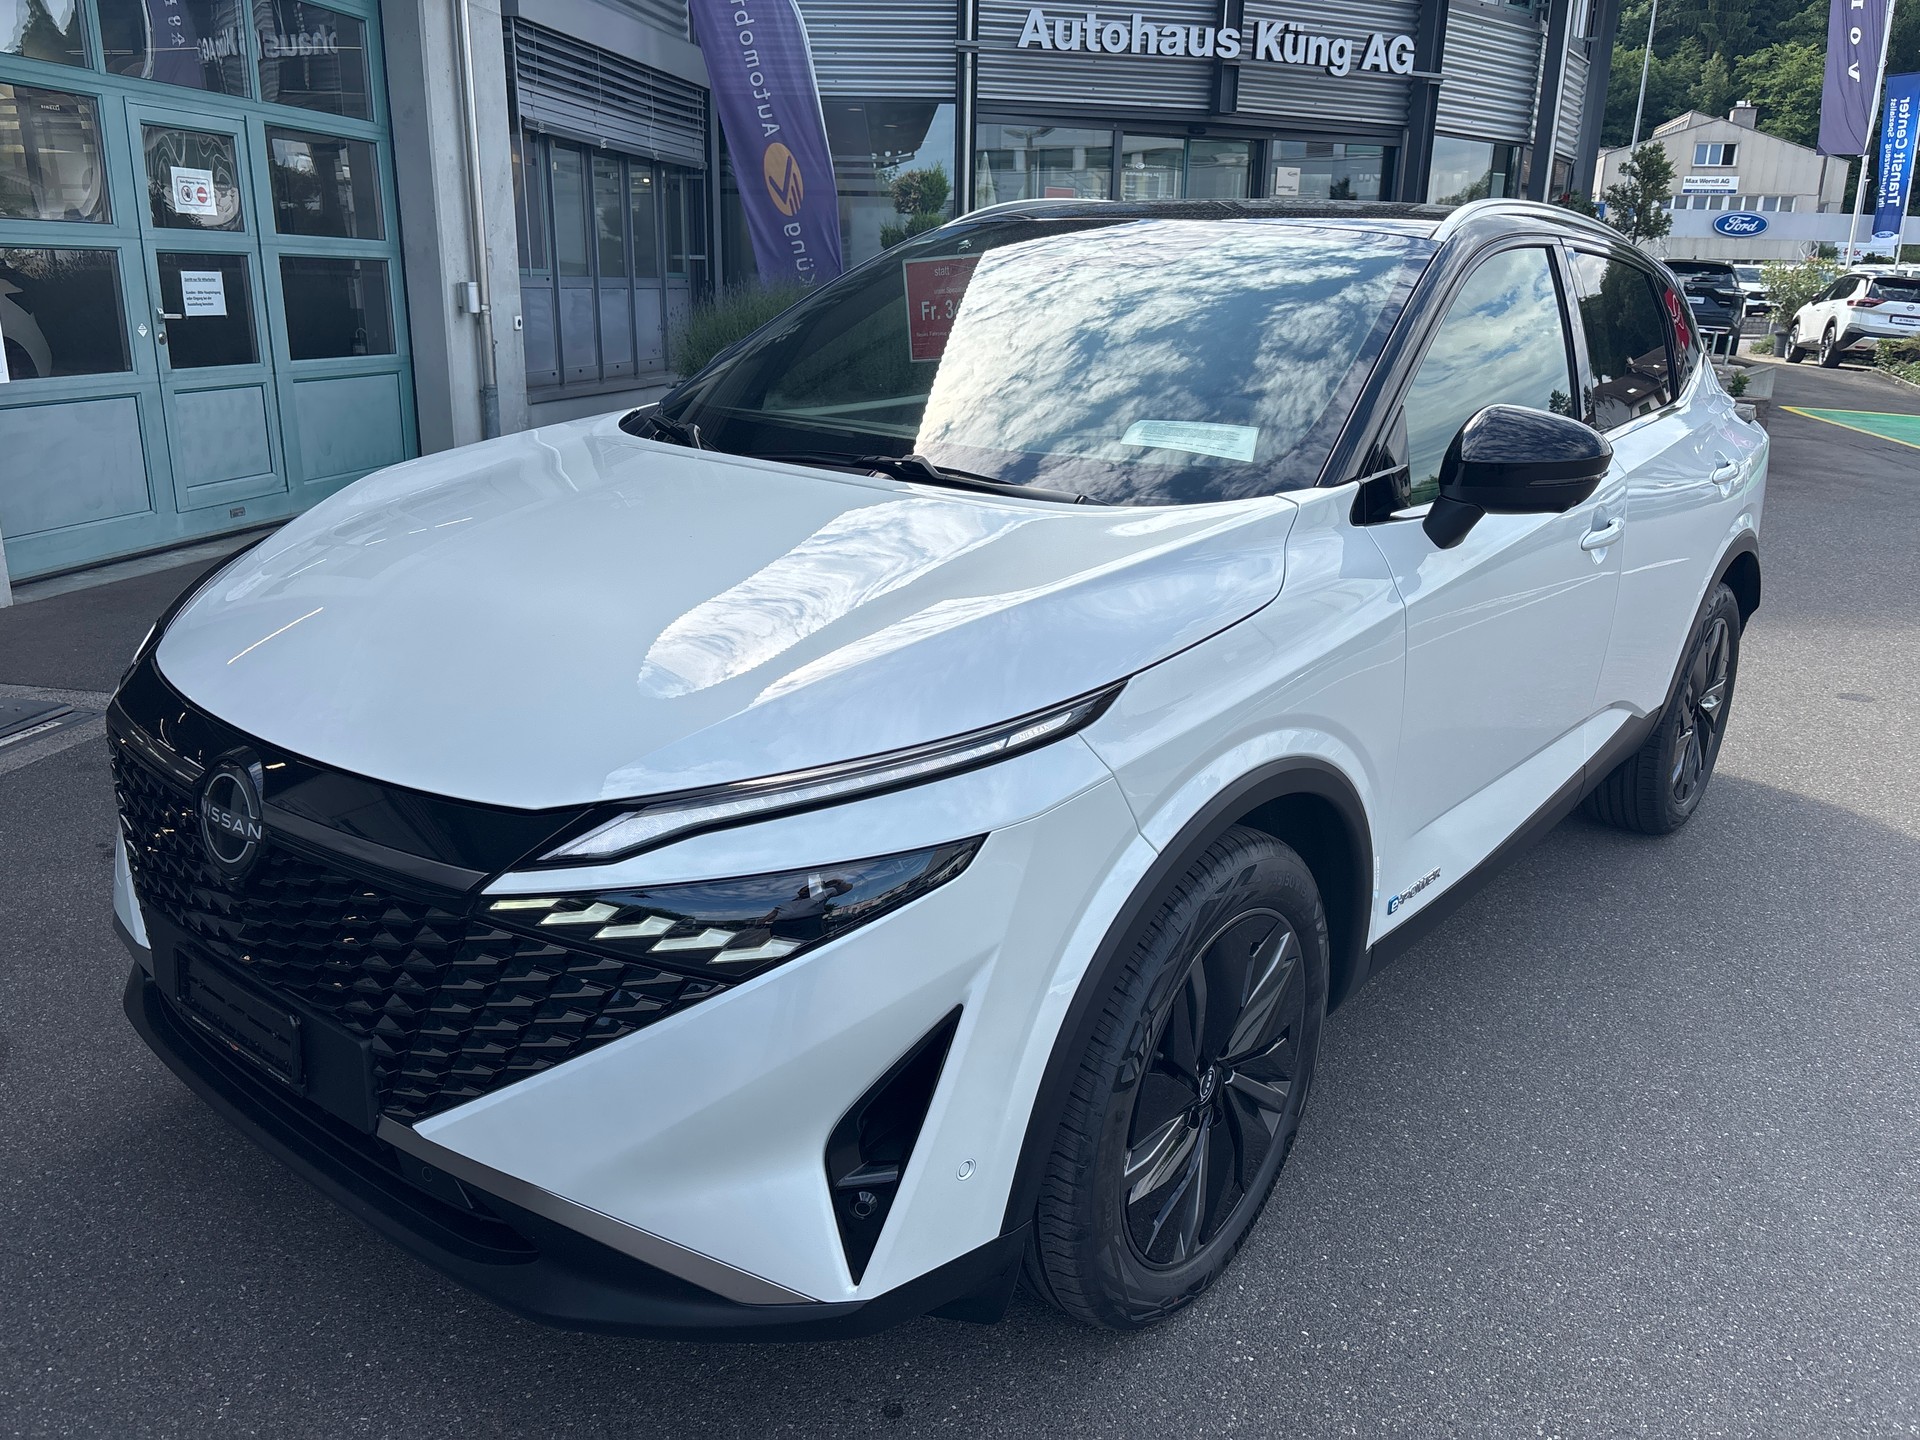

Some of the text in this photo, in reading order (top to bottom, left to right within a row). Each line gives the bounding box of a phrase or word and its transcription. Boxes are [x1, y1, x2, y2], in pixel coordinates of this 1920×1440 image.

[1017, 8, 1416, 77] Autohaus Küng AG
[1724, 215, 1759, 232] Ford
[934, 266, 950, 276] statt
[921, 301, 941, 320] Fr.
[201, 796, 262, 840] NISSAN
[1387, 866, 1441, 915] e-POWER
